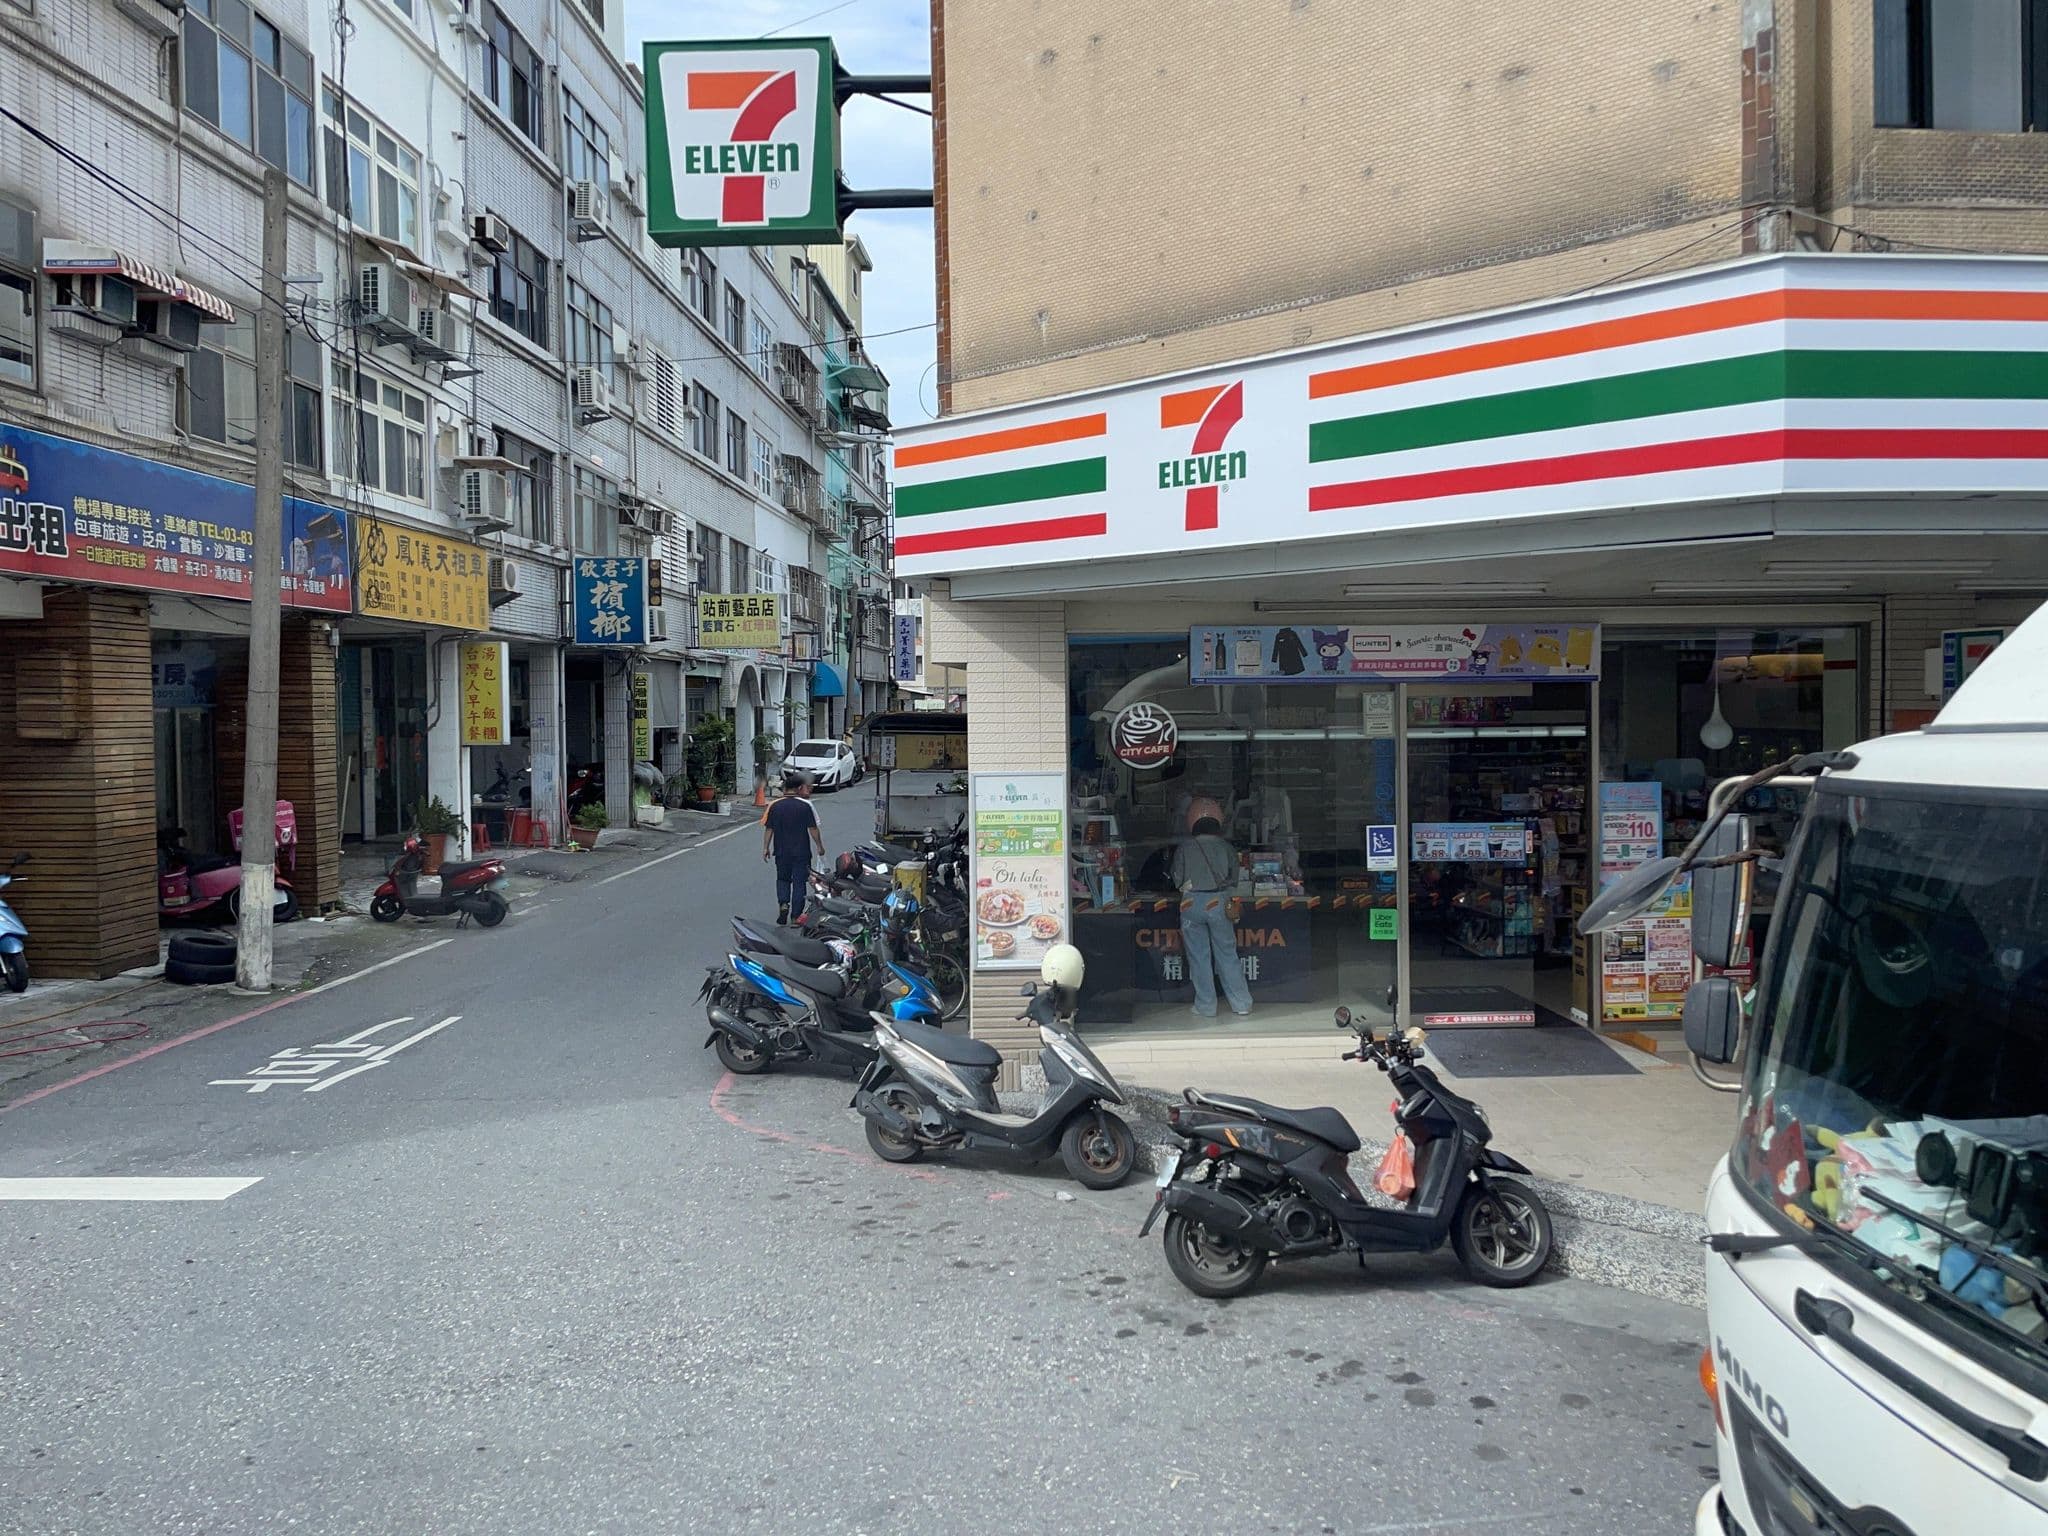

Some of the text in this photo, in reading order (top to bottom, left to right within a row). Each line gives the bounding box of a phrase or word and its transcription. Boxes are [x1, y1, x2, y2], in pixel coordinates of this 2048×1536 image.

[702, 598, 774, 617] 站前藝品店
[1120, 745, 1170, 757] CITY CAFE
